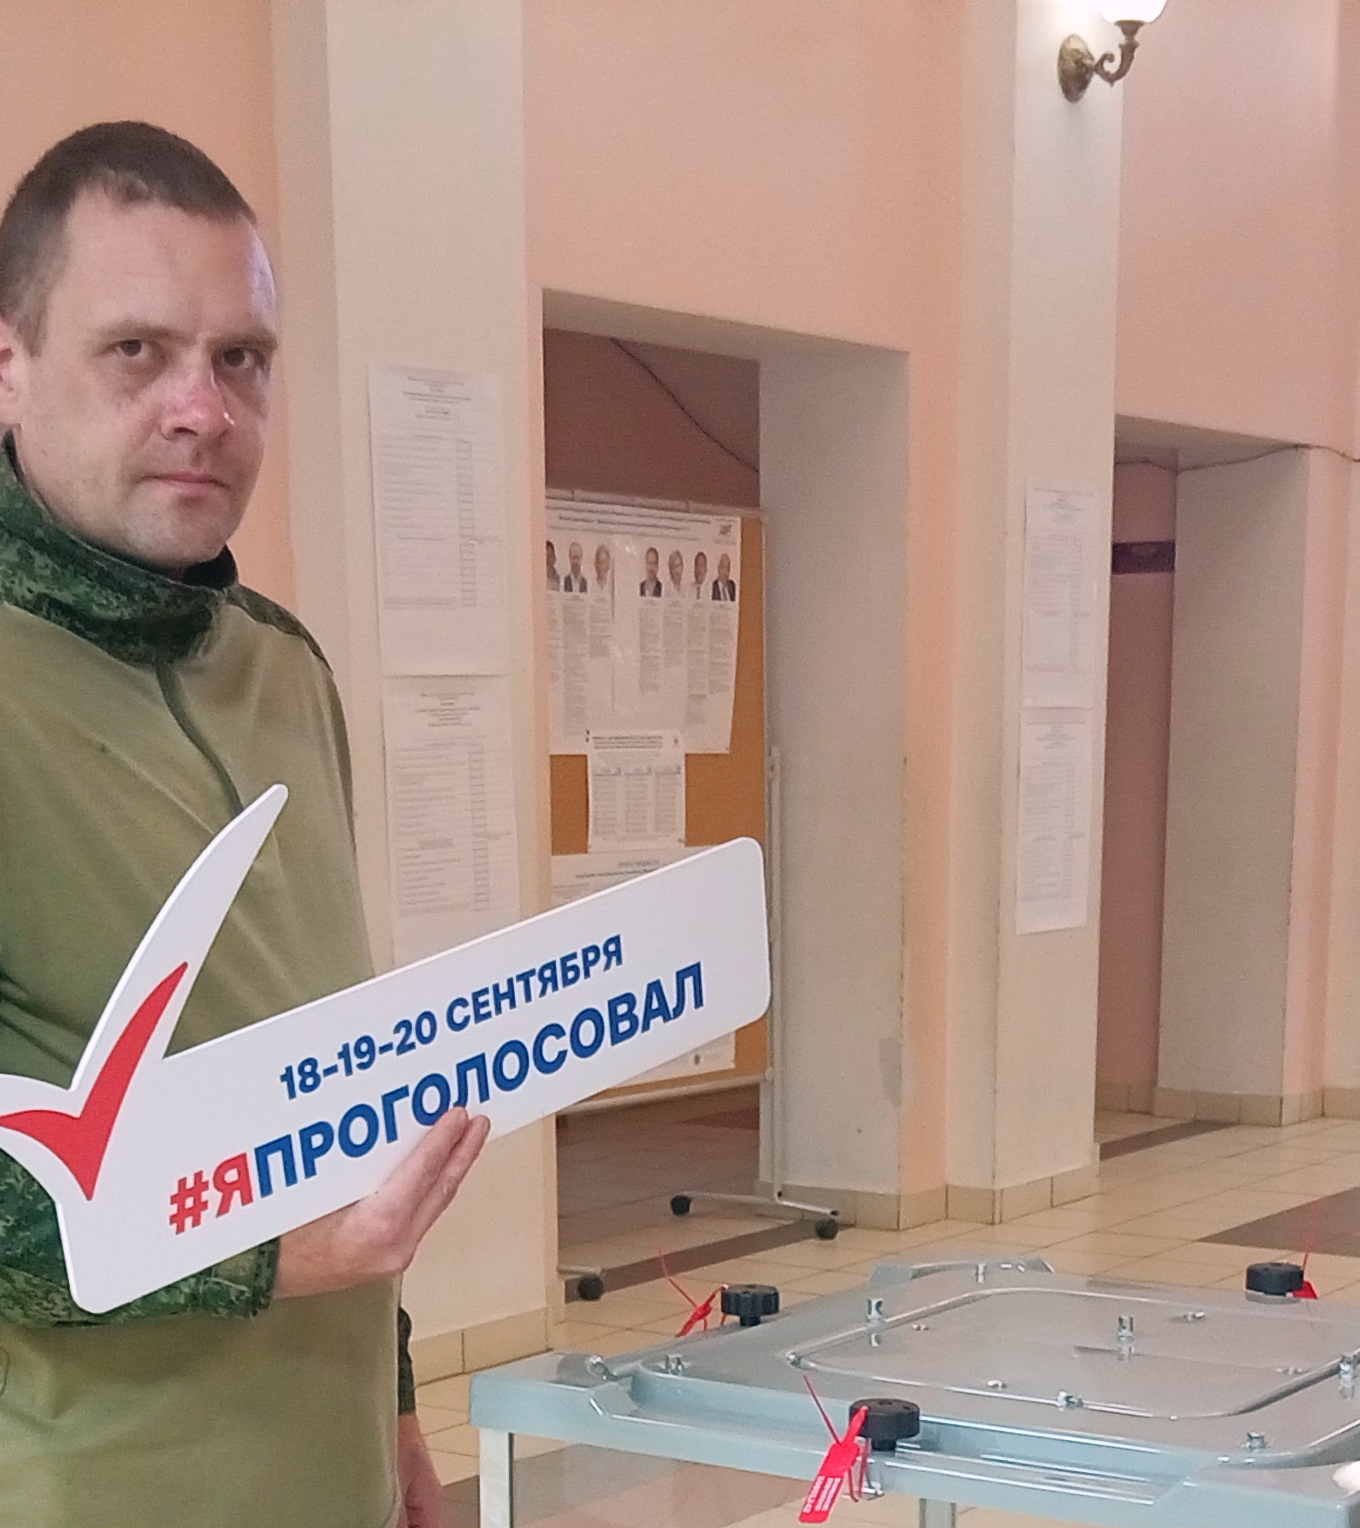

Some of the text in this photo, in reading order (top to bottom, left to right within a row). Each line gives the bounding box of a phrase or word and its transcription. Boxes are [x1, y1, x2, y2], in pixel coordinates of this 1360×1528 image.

[168, 962, 704, 1236] #ЯПРОГОЛОСОВАЛ
[280, 934, 623, 1100] 18-19-20 СЕНТЯБРЯ
